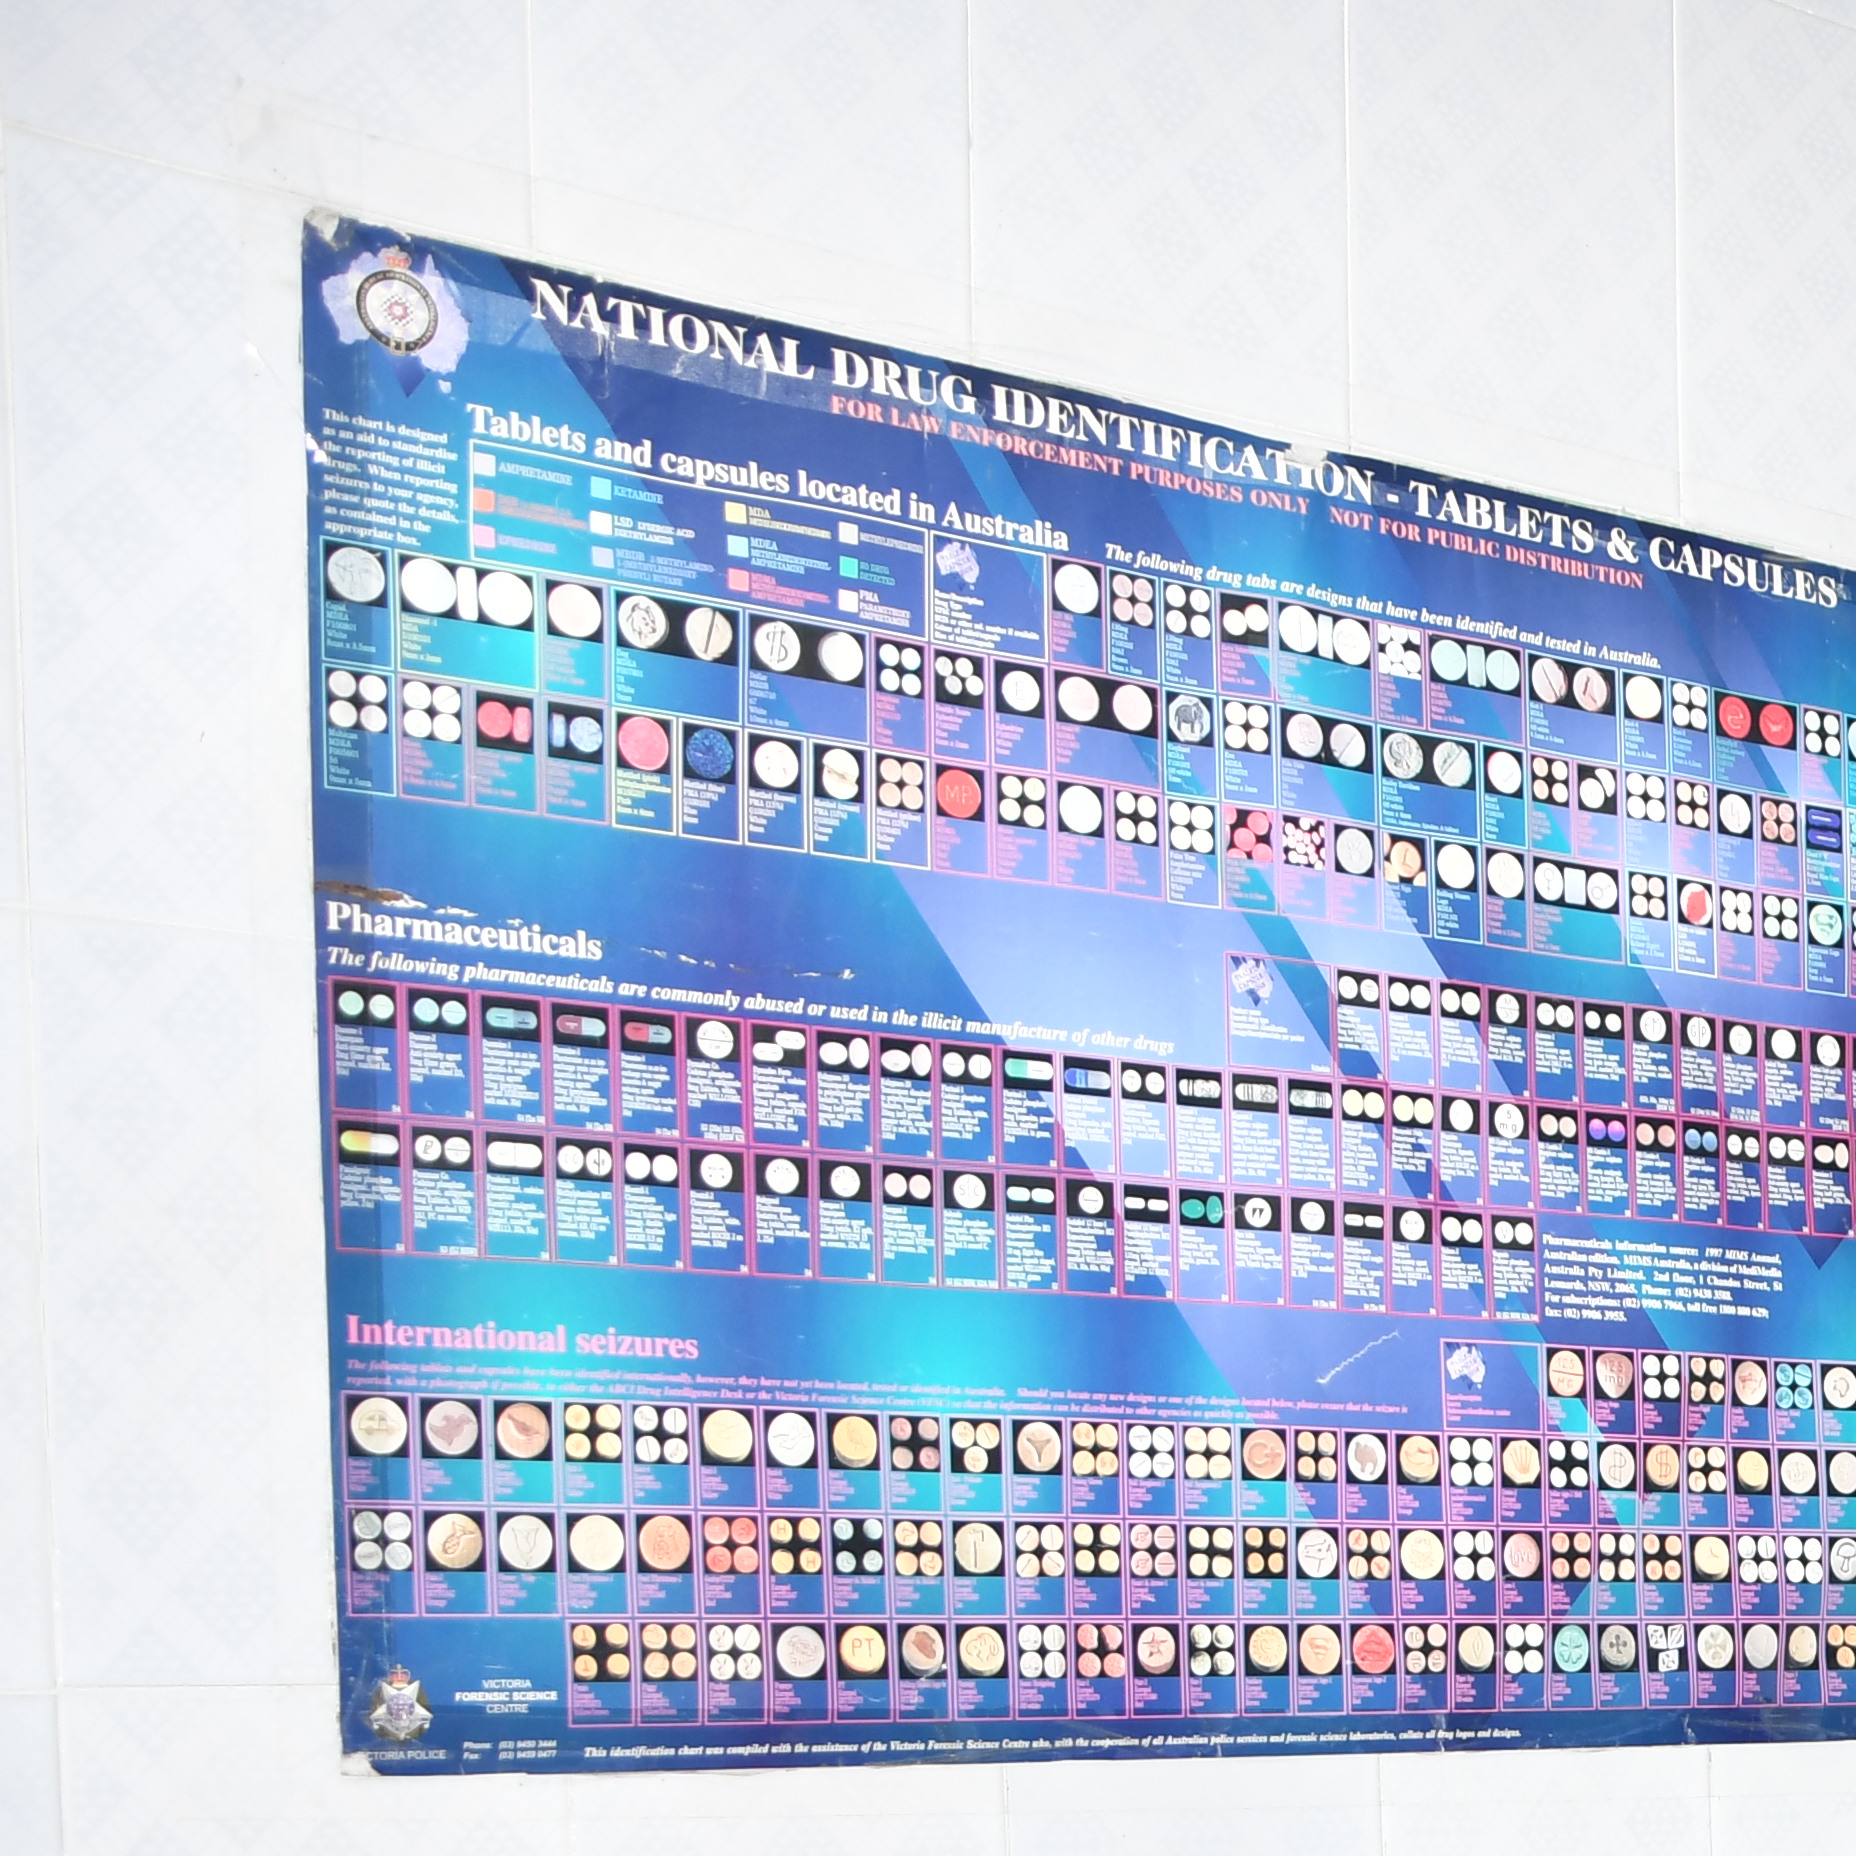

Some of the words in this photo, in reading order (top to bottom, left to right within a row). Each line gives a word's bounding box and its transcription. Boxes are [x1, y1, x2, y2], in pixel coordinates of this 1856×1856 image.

[322, 407, 350, 423] This
[351, 412, 383, 431] chart
[385, 420, 396, 433] is
[398, 423, 448, 446] designed
[322, 426, 336, 437] as
[338, 429, 354, 439] an
[356, 429, 375, 443] aid
[377, 435, 391, 447] to
[391, 438, 459, 461] standardise
[530, 277, 815, 381] NATIONAL
[829, 346, 979, 415] DRUG
[991, 383, 1375, 506] IDENTIFICATION
[1409, 479, 1596, 555] TABLETS
[1606, 526, 1639, 565] &
[1649, 536, 1840, 609] CAPSULES
[323, 440, 343, 453] the
[345, 445, 400, 468] reporting
[402, 455, 415, 468] of
[416, 457, 446, 475] illicit
[499, 462, 573, 486] AMPHETAMINE
[323, 457, 362, 474] drugs.
[367, 464, 402, 481] When
[403, 472, 459, 494] reporting
[323, 473, 371, 490] seizures
[374, 481, 386, 493] to
[387, 485, 414, 501] your
[416, 491, 459, 509] agency,
[466, 403, 587, 454] Tablets
[594, 434, 653, 469] and
[660, 447, 791, 495] capsules
[798, 470, 902, 517] located
[908, 493, 936, 524] in
[941, 501, 1070, 552] Australia
[829, 394, 885, 423] FOR
[890, 406, 943, 437] LAW
[949, 419, 1123, 477] ENFORCEMENT
[1129, 460, 1243, 503] PURPOSES
[1250, 489, 1310, 516] ONLY
[1329, 505, 1373, 531] NOT
[1378, 517, 1422, 543] FOR
[1427, 528, 1501, 559] PUBLIC
[1505, 544, 1645, 590] DISTRIBUTION
[324, 488, 362, 505] please
[363, 495, 396, 513] quote
[398, 502, 417, 515] the
[418, 505, 460, 524] details,
[324, 505, 337, 515] as
[339, 507, 397, 527] contained
[399, 517, 411, 529] in
[412, 520, 432, 533] the
[614, 515, 634, 529] LSD
[748, 506, 771, 519] MDA
[324, 521, 394, 544] appropriate
[396, 529, 421, 547] box.
[1105, 542, 1132, 563] The
[1133, 549, 1204, 581] following
[1206, 565, 1242, 589] drug
[1246, 574, 1277, 591] tabs
[1280, 581, 1304, 595] are
[1306, 583, 1353, 609] designs
[1356, 594, 1383, 614] that
[1386, 600, 1418, 622] have
[1420, 608, 1453, 628] been
[1456, 614, 1518, 640] identified
[1519, 627, 1543, 647] and
[1545, 631, 1581, 656] tested
[1583, 639, 1597, 658] in
[1599, 645, 1662, 670] Australia.
[326, 900, 603, 961] Pharmaceuticals
[327, 946, 365, 968] The
[367, 949, 460, 982] following
[462, 964, 615, 993] pharmaceuticals
[617, 981, 647, 998] are
[650, 984, 741, 1010] commonly
[743, 993, 804, 1015] abused
[807, 1003, 828, 1017] or
[830, 1002, 869, 1022] used
[871, 1006, 889, 1024] in
[892, 1009, 918, 1028] the
[921, 1011, 963, 1033] illicit
[965, 1022, 1067, 1043] manufacture
[1070, 1027, 1089, 1047] of
[1090, 1029, 1130, 1049] other
[1132, 1033, 1175, 1055] drugs
[345, 1313, 567, 1353] International
[575, 1327, 699, 1360] seizures
[455, 1691, 510, 1701] FORENSIC
[512, 1691, 558, 1701] SCIENCE
[481, 1679, 532, 1689] VICTORIA
[486, 1703, 529, 1714] CENTRE
[407, 1749, 447, 1760] POLICE
